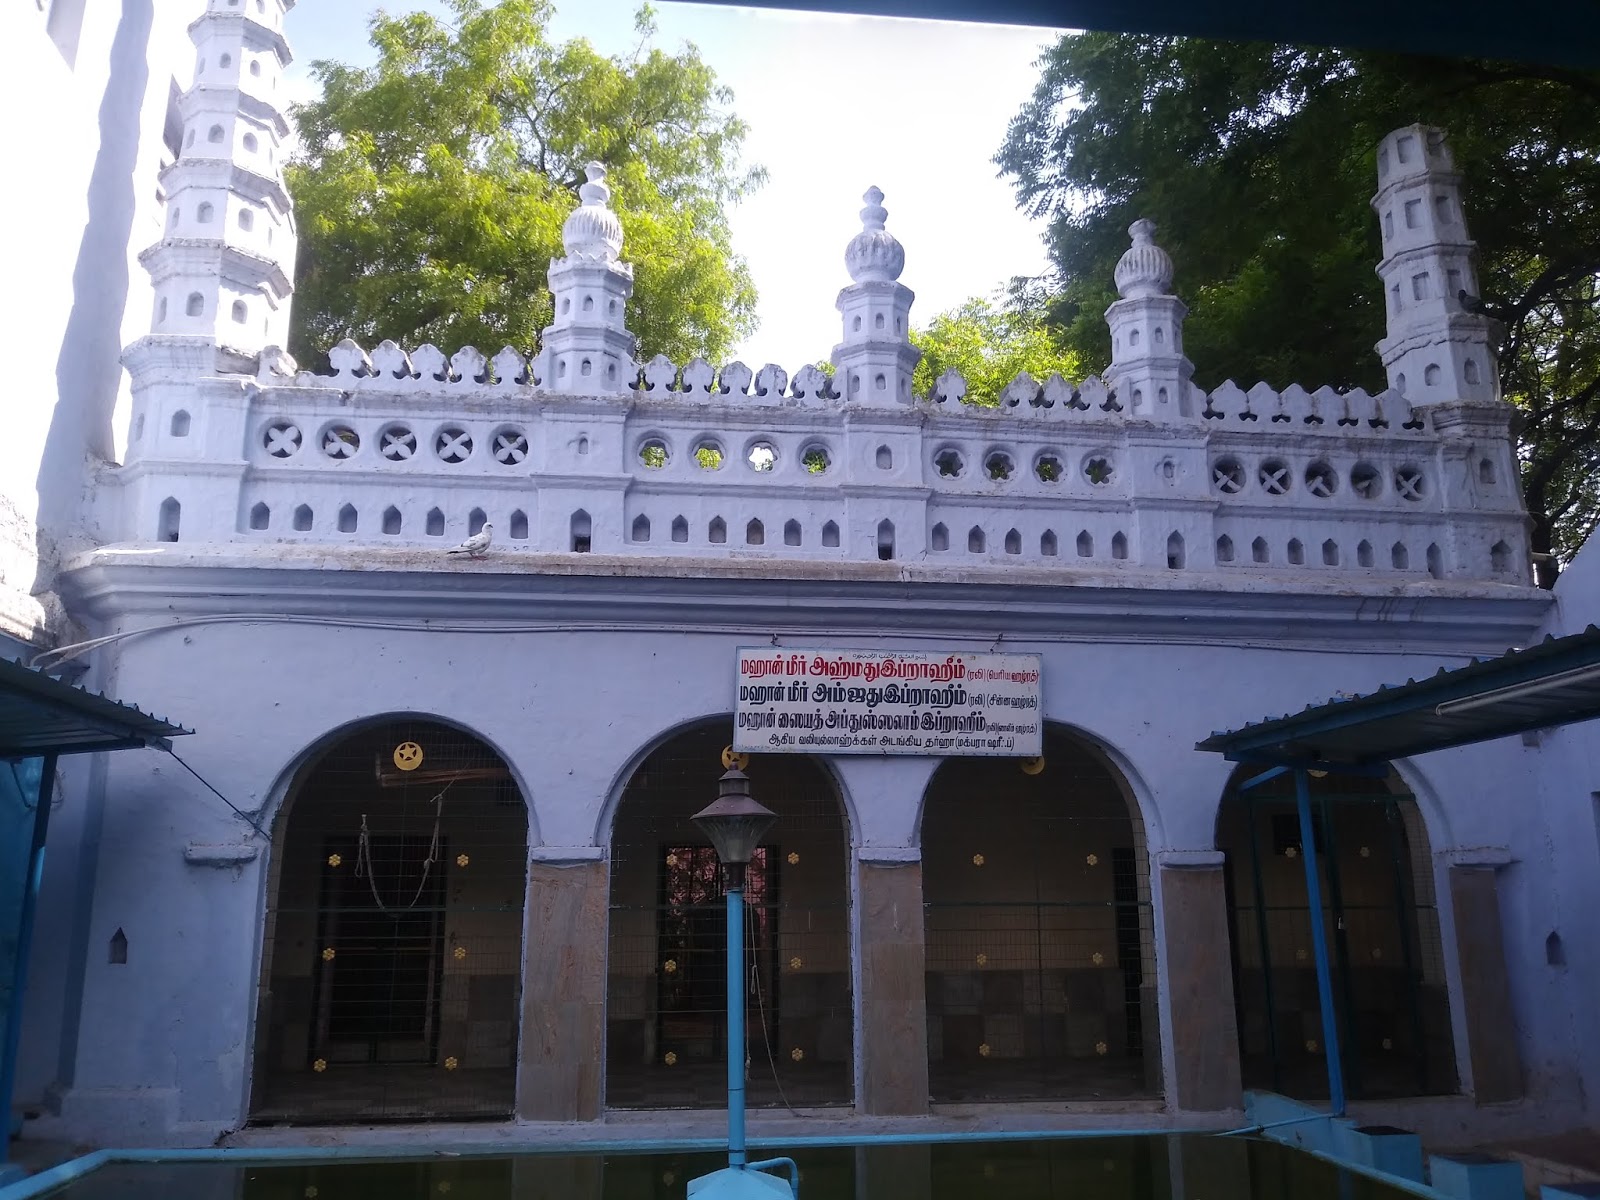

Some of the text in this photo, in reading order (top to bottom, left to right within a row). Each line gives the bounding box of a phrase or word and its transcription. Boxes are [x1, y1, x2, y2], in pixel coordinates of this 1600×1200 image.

[741, 654, 784, 678] மஹான்
[786, 654, 807, 676] மீர்
[740, 681, 785, 705] மஹான்
[787, 680, 809, 702] மீர்
[738, 707, 776, 731] மஹான்
[769, 733, 795, 746] ஆகிய
[879, 735, 922, 747] அடங்கிய
